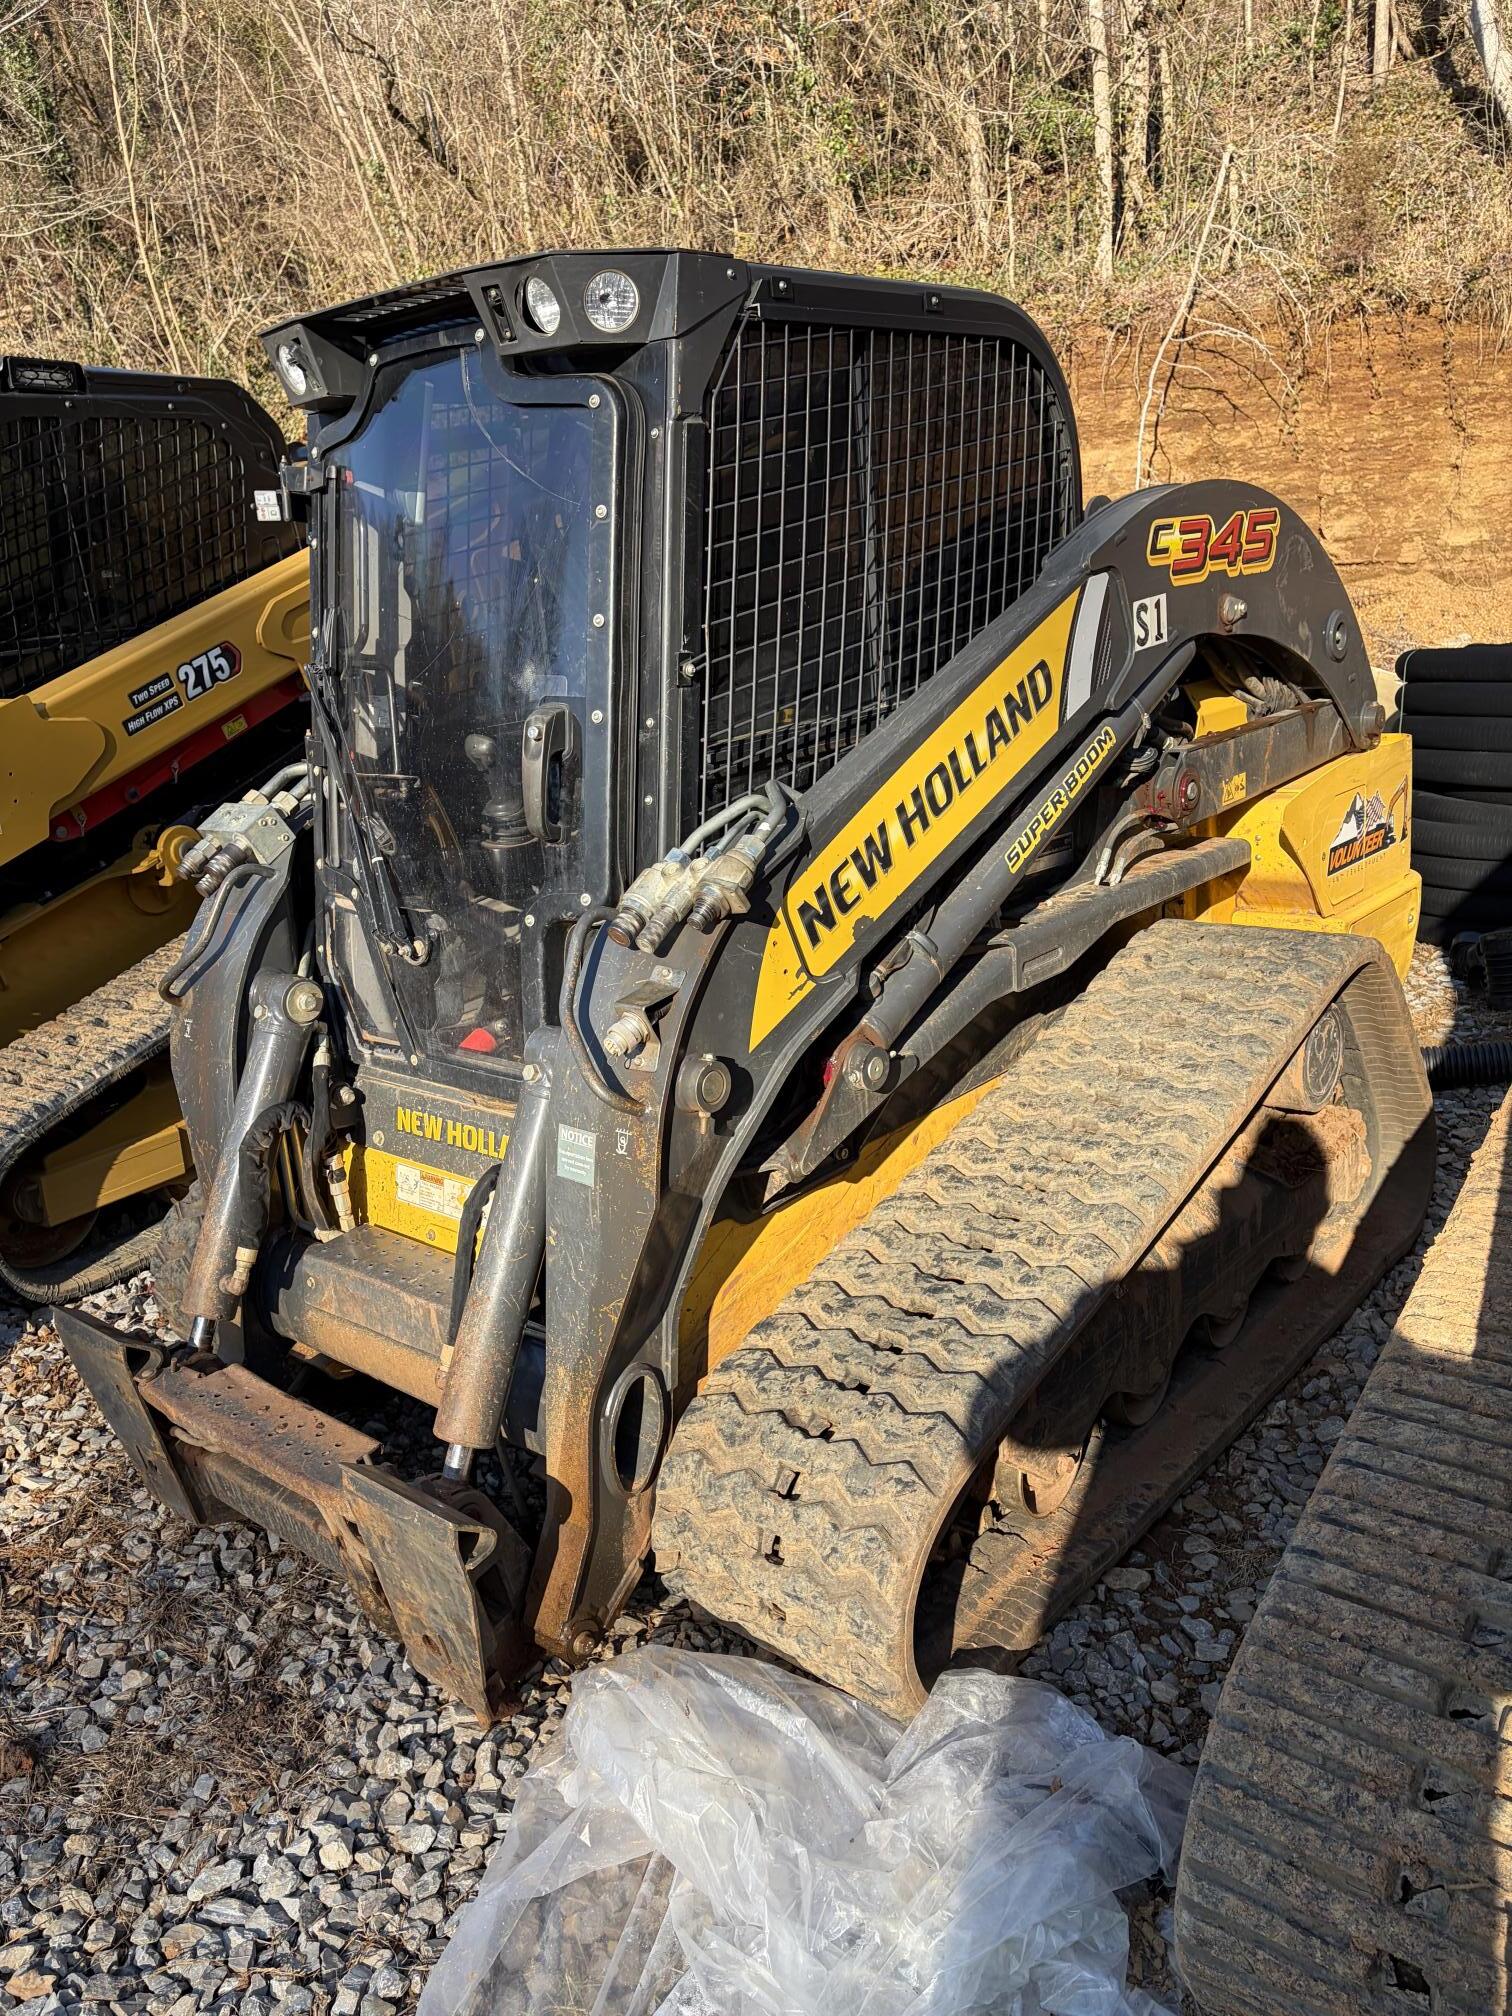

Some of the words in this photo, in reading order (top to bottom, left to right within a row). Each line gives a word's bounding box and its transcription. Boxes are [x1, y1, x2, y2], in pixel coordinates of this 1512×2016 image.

[1147, 508, 1280, 587] C345
[1136, 598, 1164, 647] S1
[178, 646, 231, 699] 275
[164, 695, 179, 711] XPS
[797, 818, 894, 951] NEW
[894, 659, 1053, 849] HOLLAND
[397, 1106, 443, 1142] NEW
[560, 1127, 594, 1147] NOTICE
